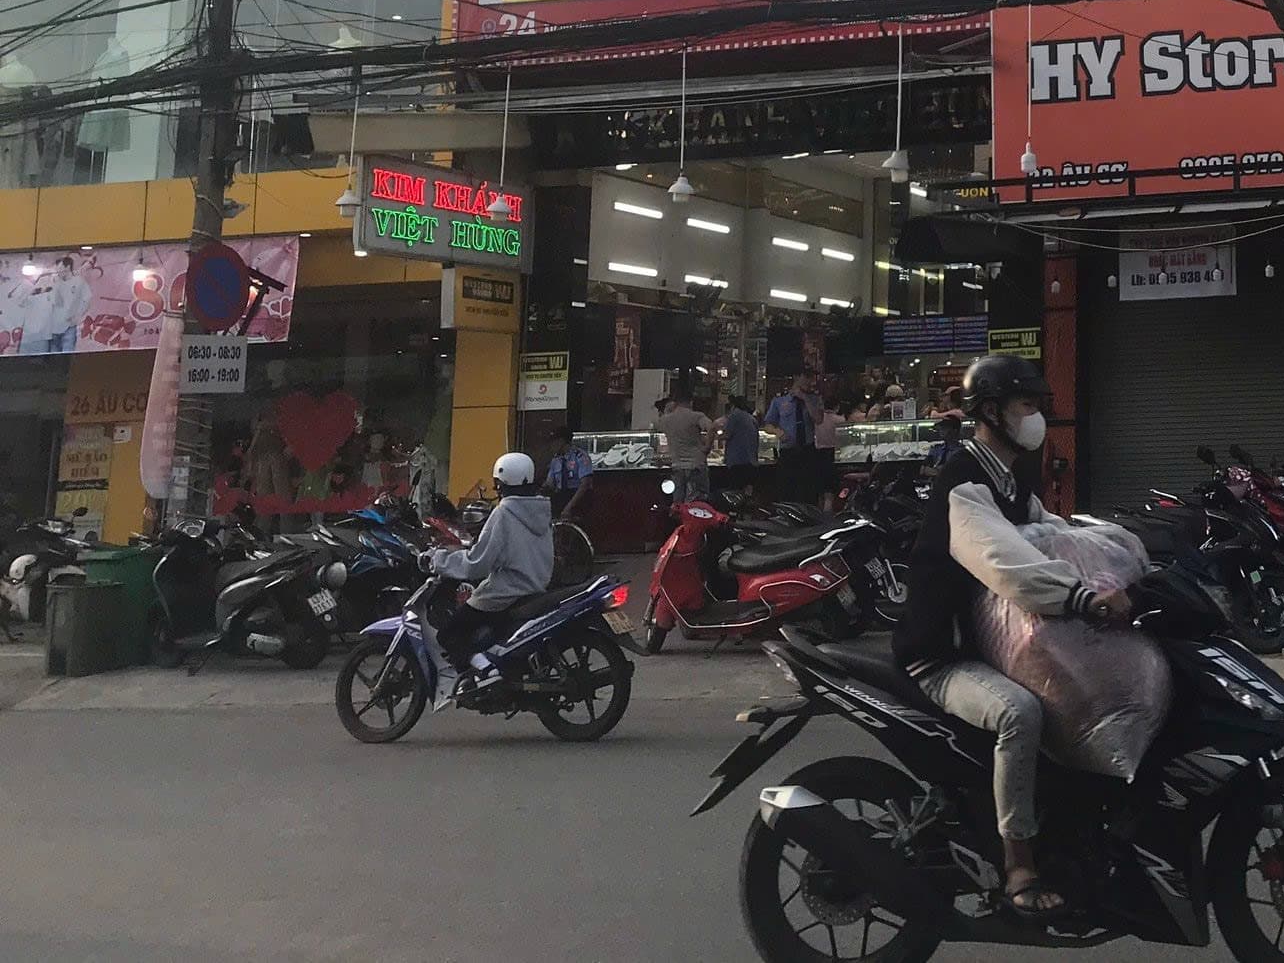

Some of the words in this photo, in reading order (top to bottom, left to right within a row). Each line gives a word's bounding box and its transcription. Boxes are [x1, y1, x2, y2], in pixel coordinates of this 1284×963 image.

[500, 10, 537, 36] 24
[1030, 37, 1124, 102] HY
[371, 169, 426, 206] KIM
[371, 206, 439, 246] VIỆT
[451, 215, 521, 256] HÙNG
[188, 346, 211, 359] 06:30
